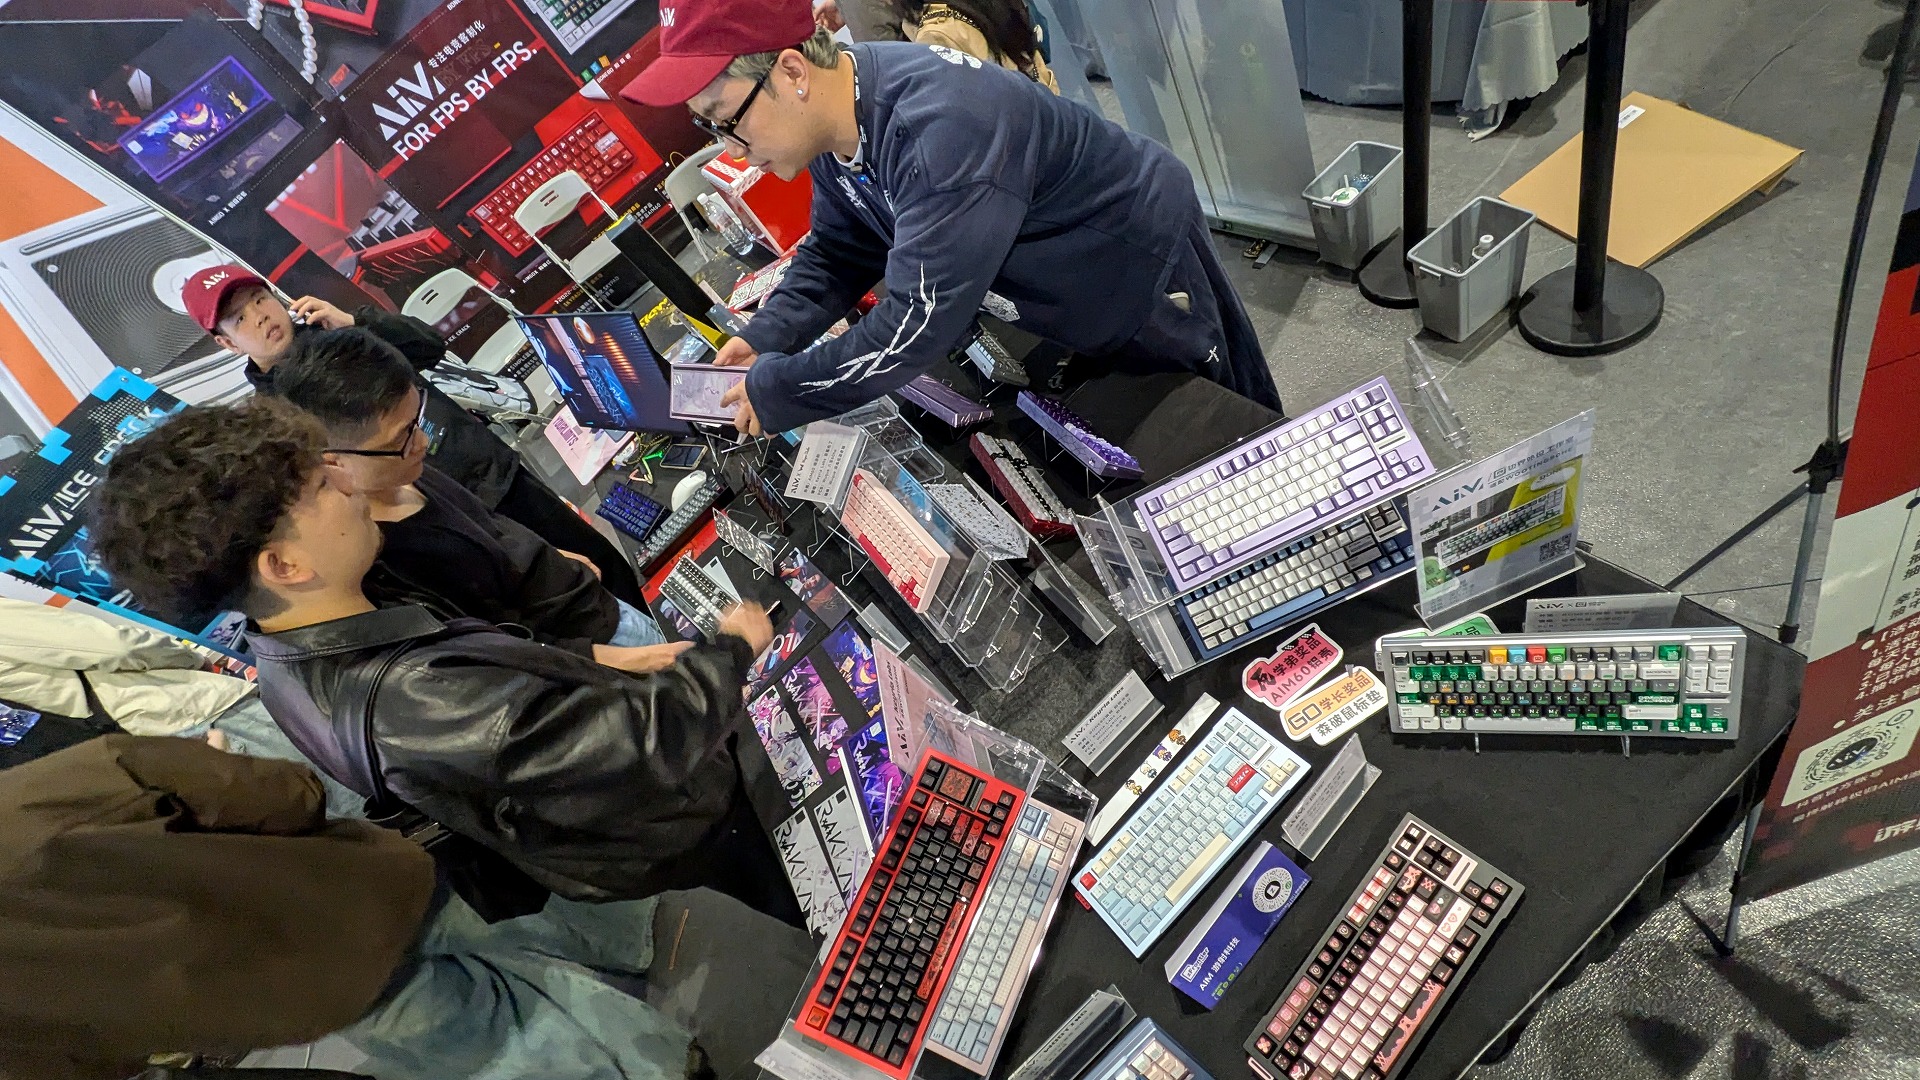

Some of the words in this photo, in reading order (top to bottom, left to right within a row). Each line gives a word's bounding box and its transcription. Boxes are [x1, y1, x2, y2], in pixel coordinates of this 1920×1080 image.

[428, 19, 486, 70] 专注电竞客制化
[393, 121, 436, 161] FOR
[430, 90, 471, 129] FPS
[465, 68, 493, 100] BY
[492, 39, 538, 78] FPS.
[1270, 645, 1338, 703] AIM60铝壳
[1315, 688, 1384, 737] 森破鼠标垫
[1199, 972, 1215, 992] AIM
[1211, 936, 1240, 973] 游射科技
